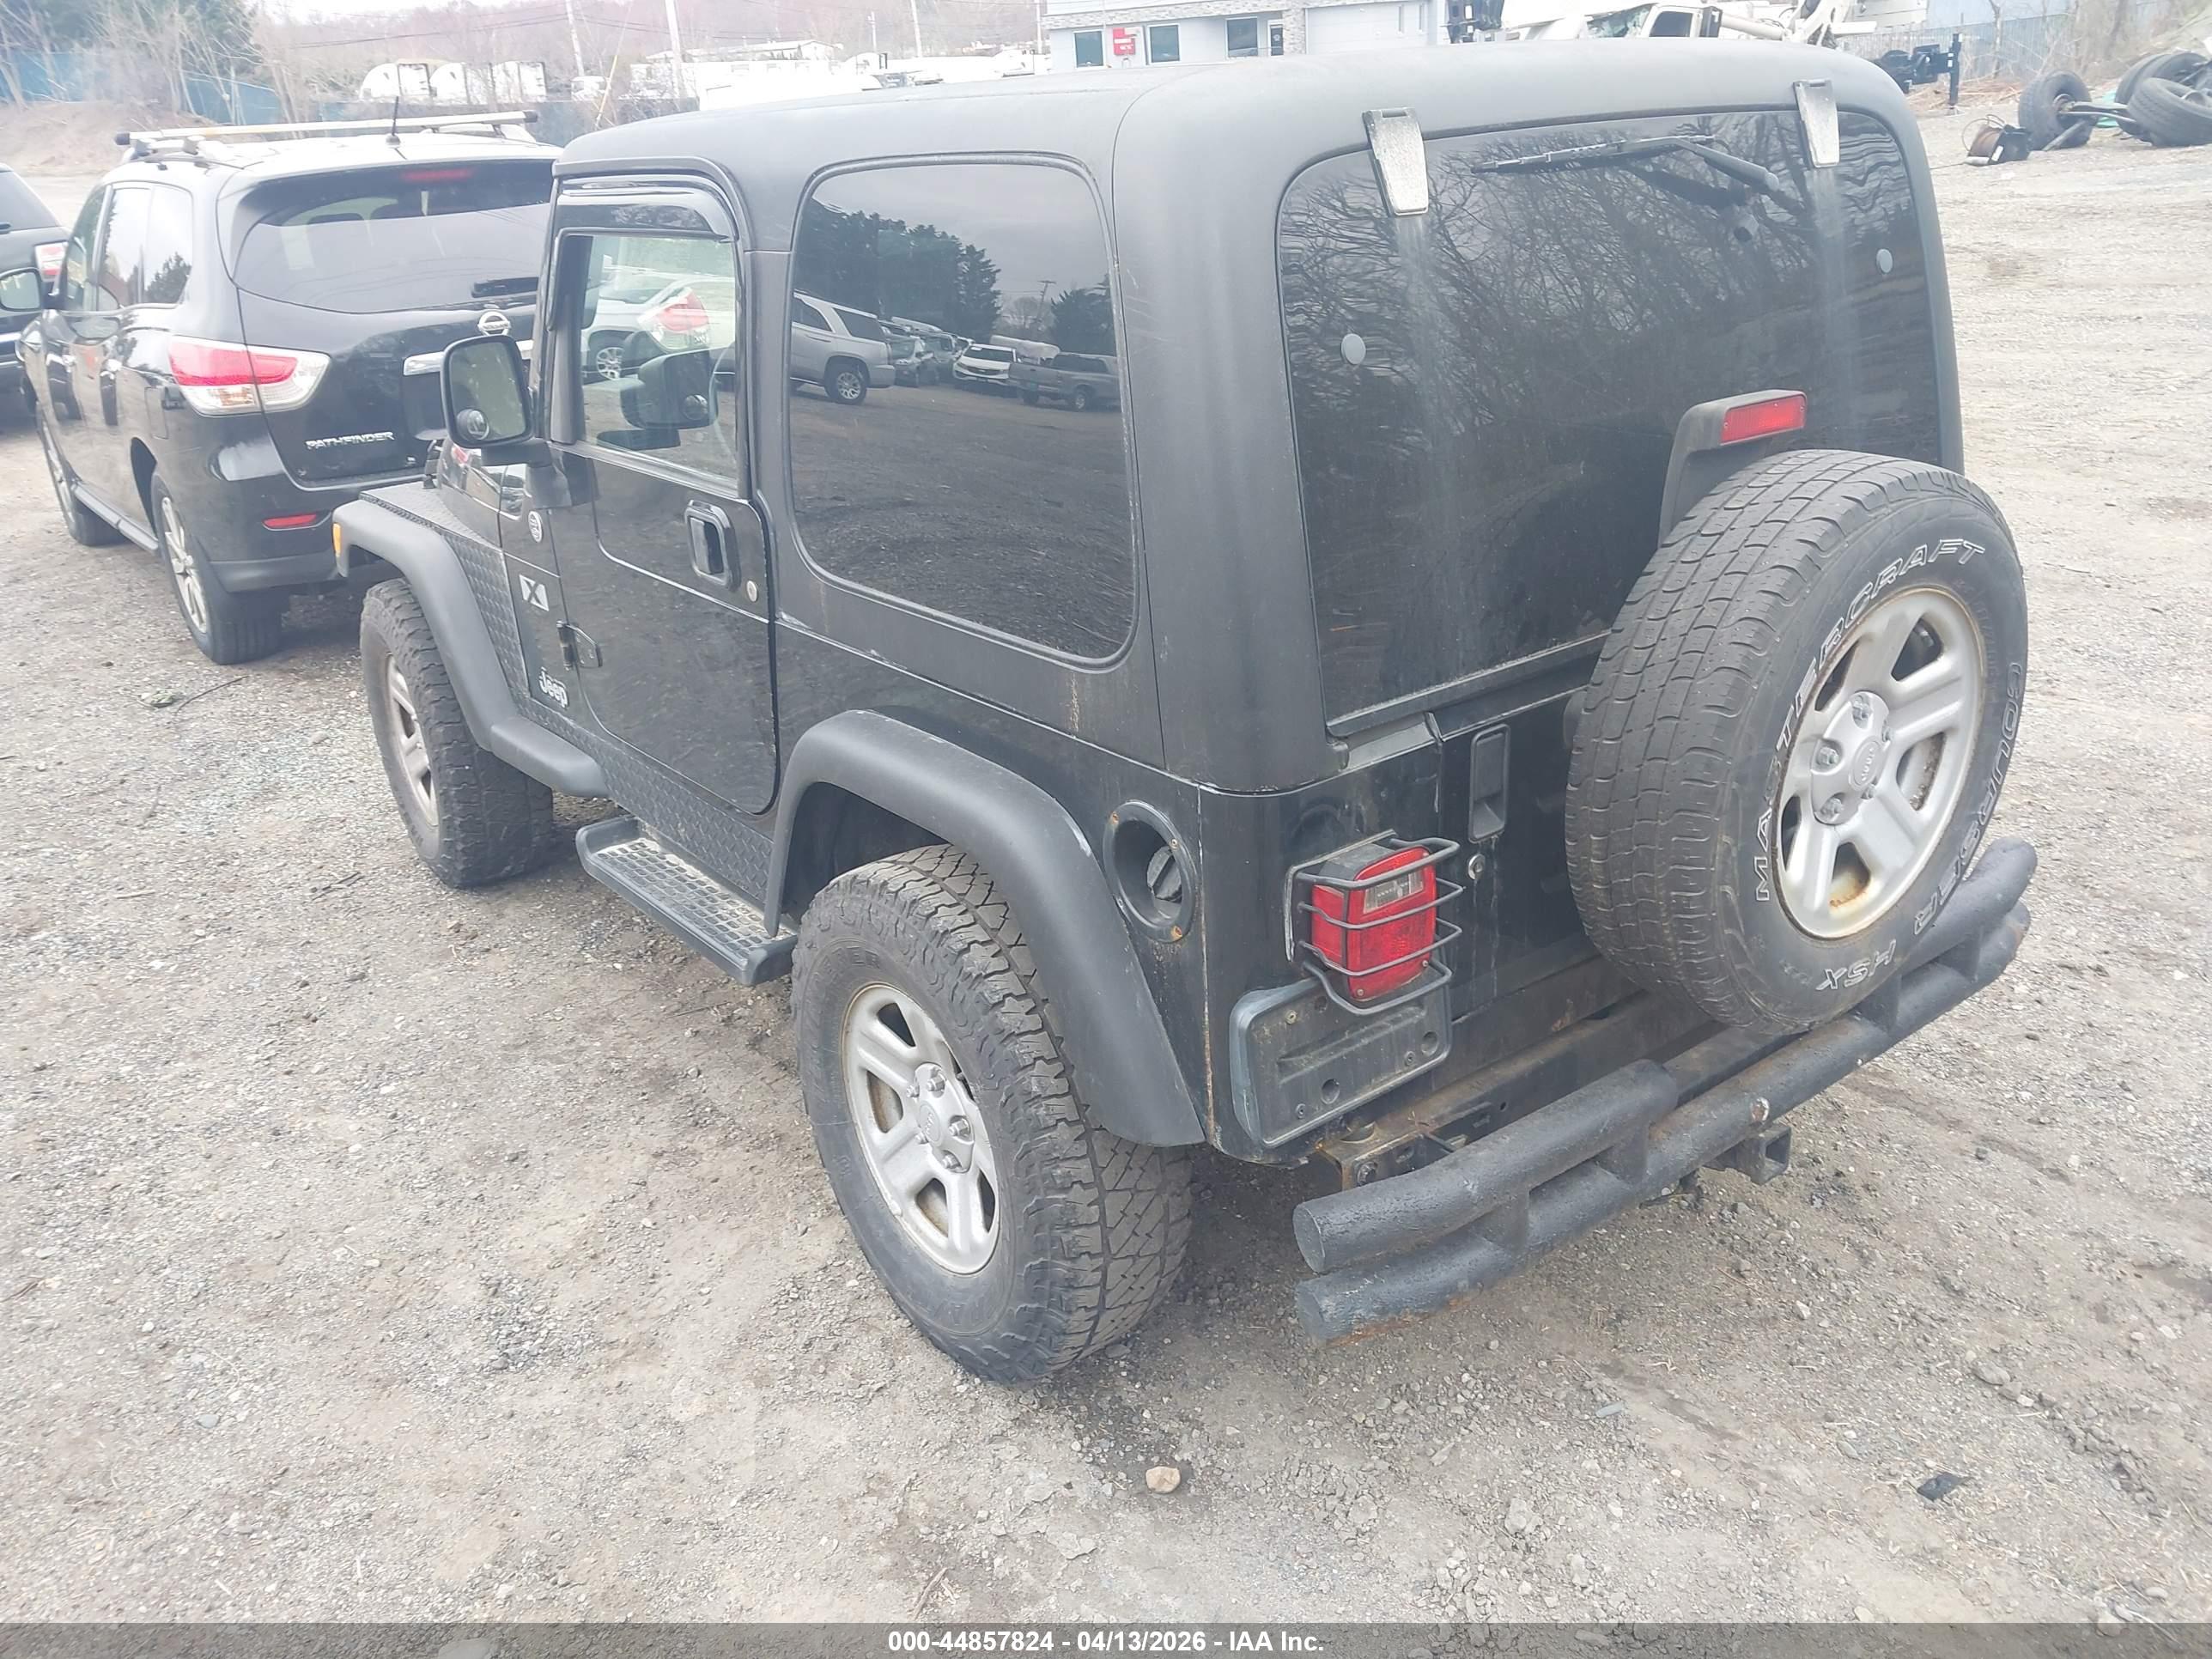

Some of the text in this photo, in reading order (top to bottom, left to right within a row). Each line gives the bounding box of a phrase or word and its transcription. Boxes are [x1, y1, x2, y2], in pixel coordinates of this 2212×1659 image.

[305, 431, 395, 449] PATHFINDER
[538, 666, 568, 708] Jeep
[1754, 538, 1985, 902] MASTERCRAFT
[1914, 662, 2022, 935] COURSER
[1815, 939, 1896, 991] HSX
